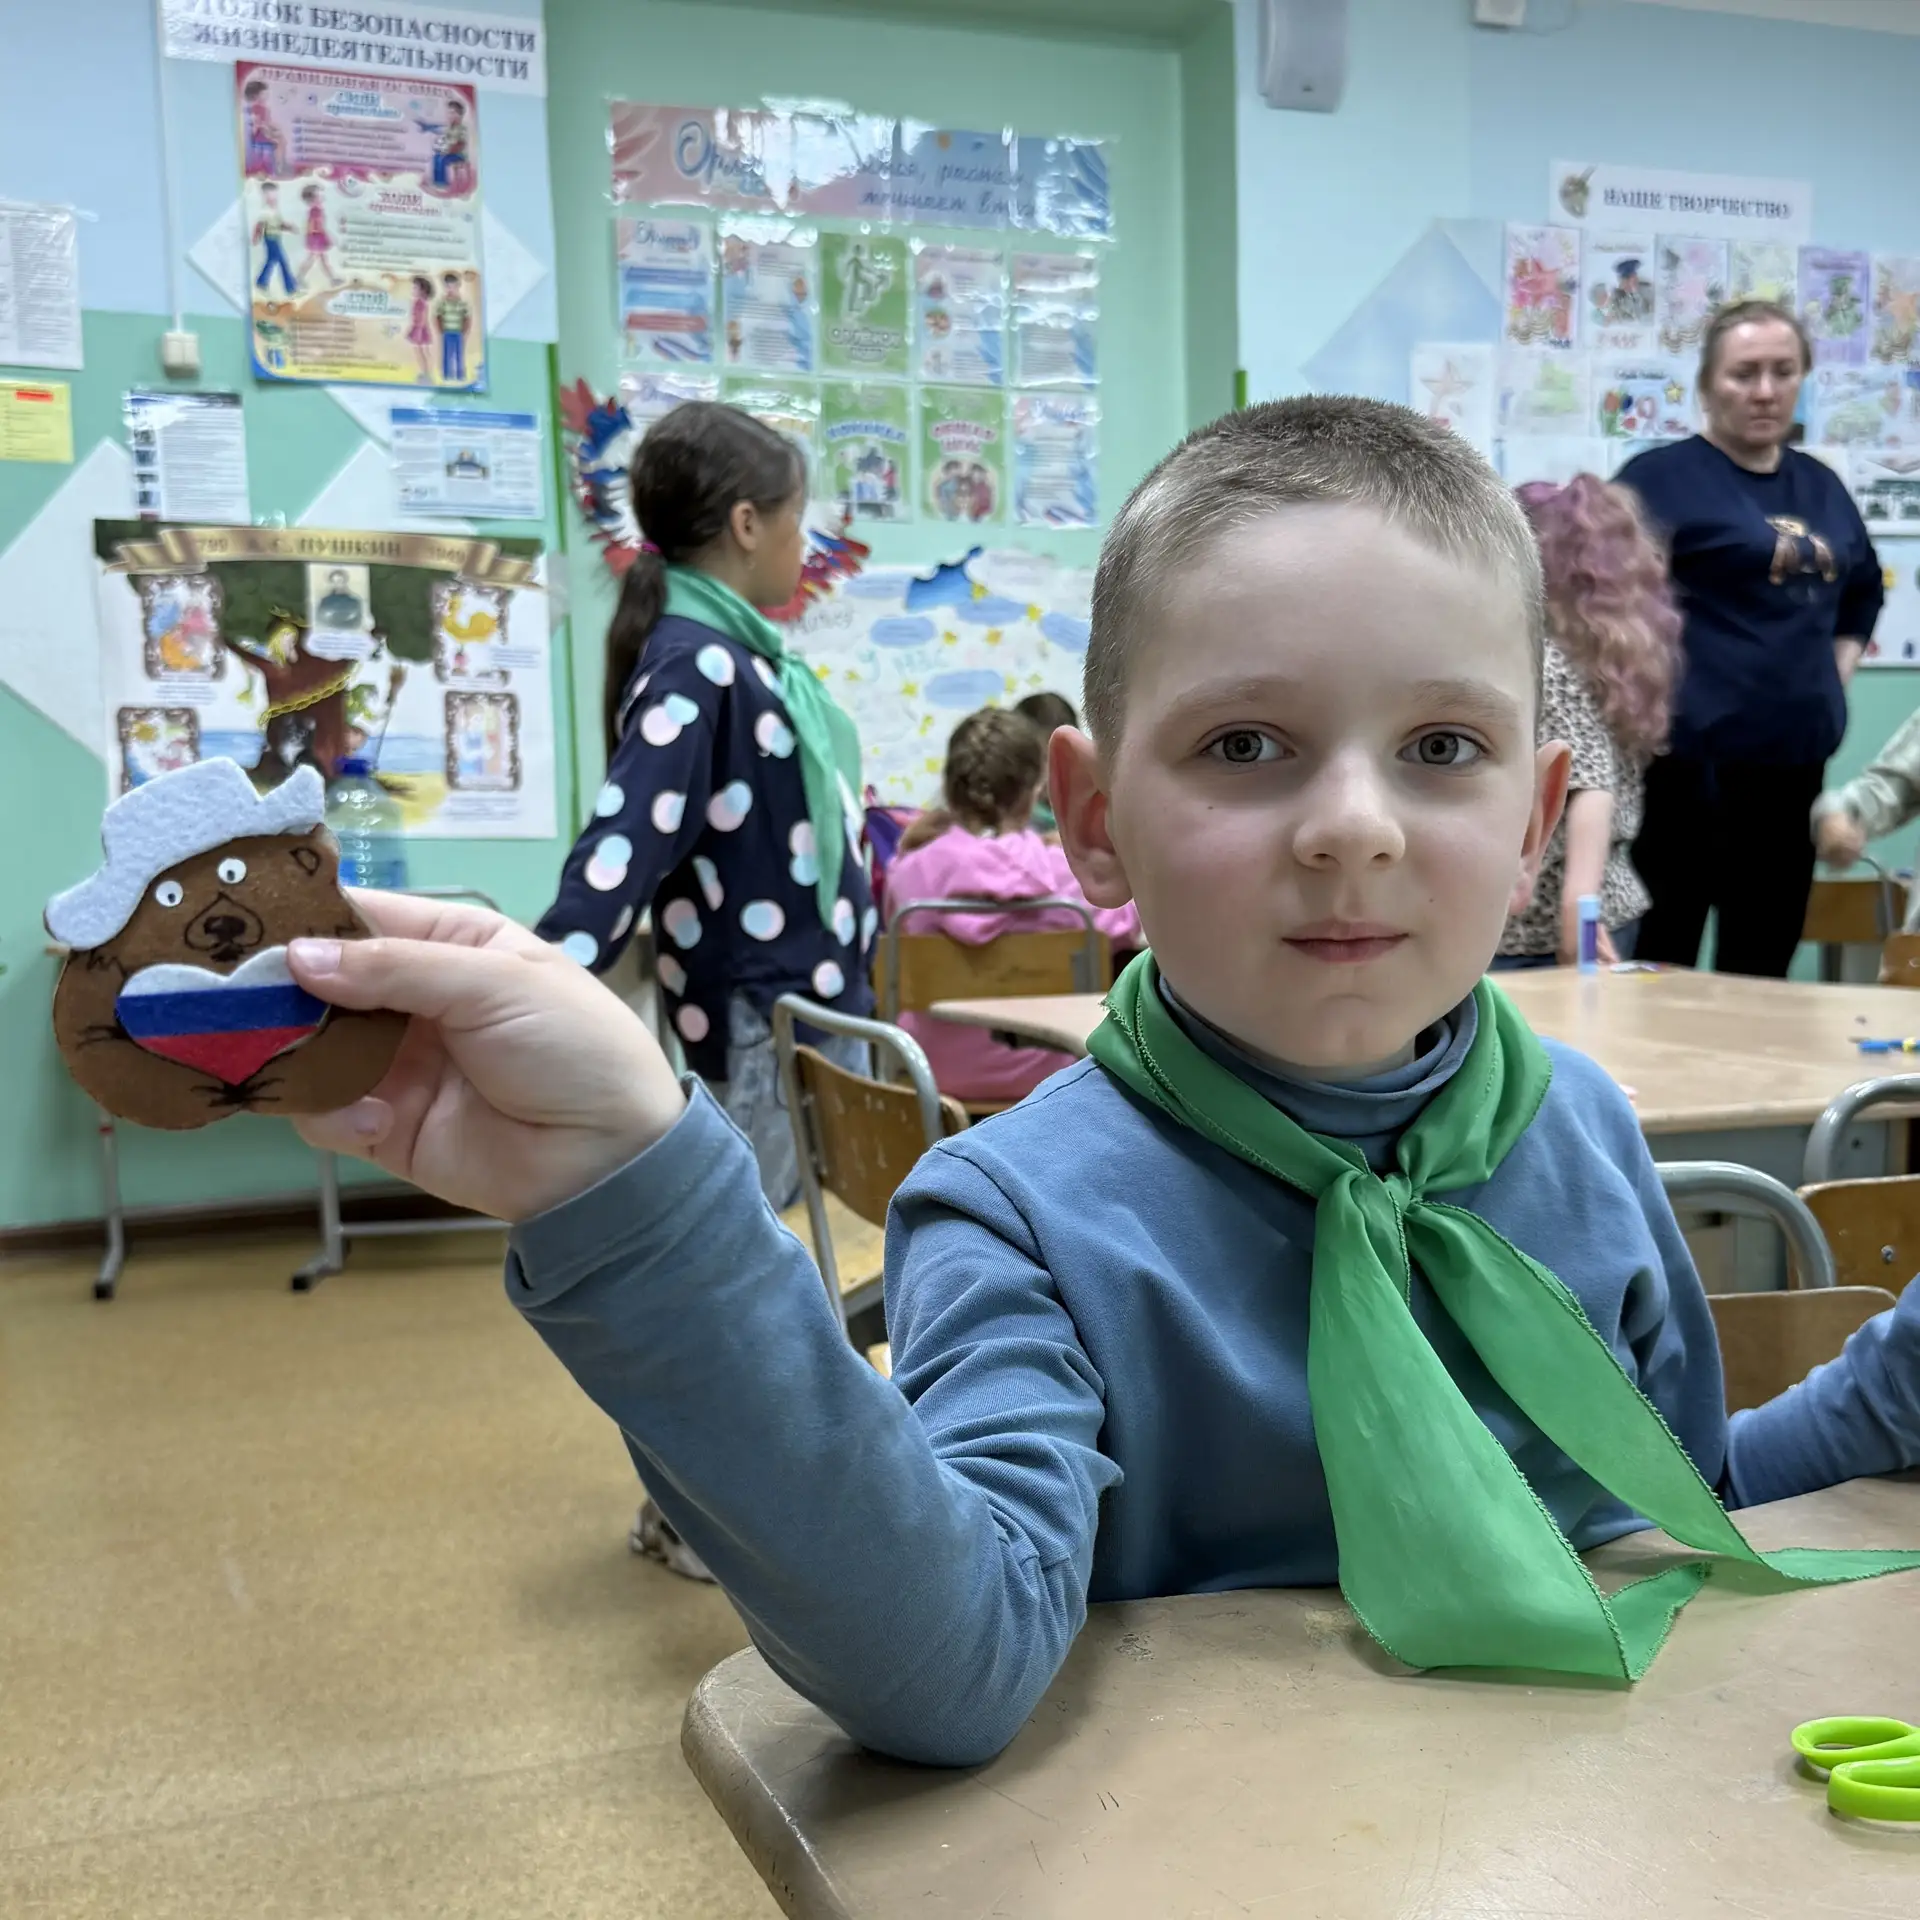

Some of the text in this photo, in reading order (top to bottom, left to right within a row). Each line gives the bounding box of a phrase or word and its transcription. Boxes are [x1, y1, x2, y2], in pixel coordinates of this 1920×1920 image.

[193, 22, 529, 80] ЖИЗНЕДЕЯТЕЛЬНОСТИ
[309, 8, 536, 52] БЕЗОПАСНОСТИ
[1603, 188, 1793, 220] НАШЕ ТВОРЧЕСТВО
